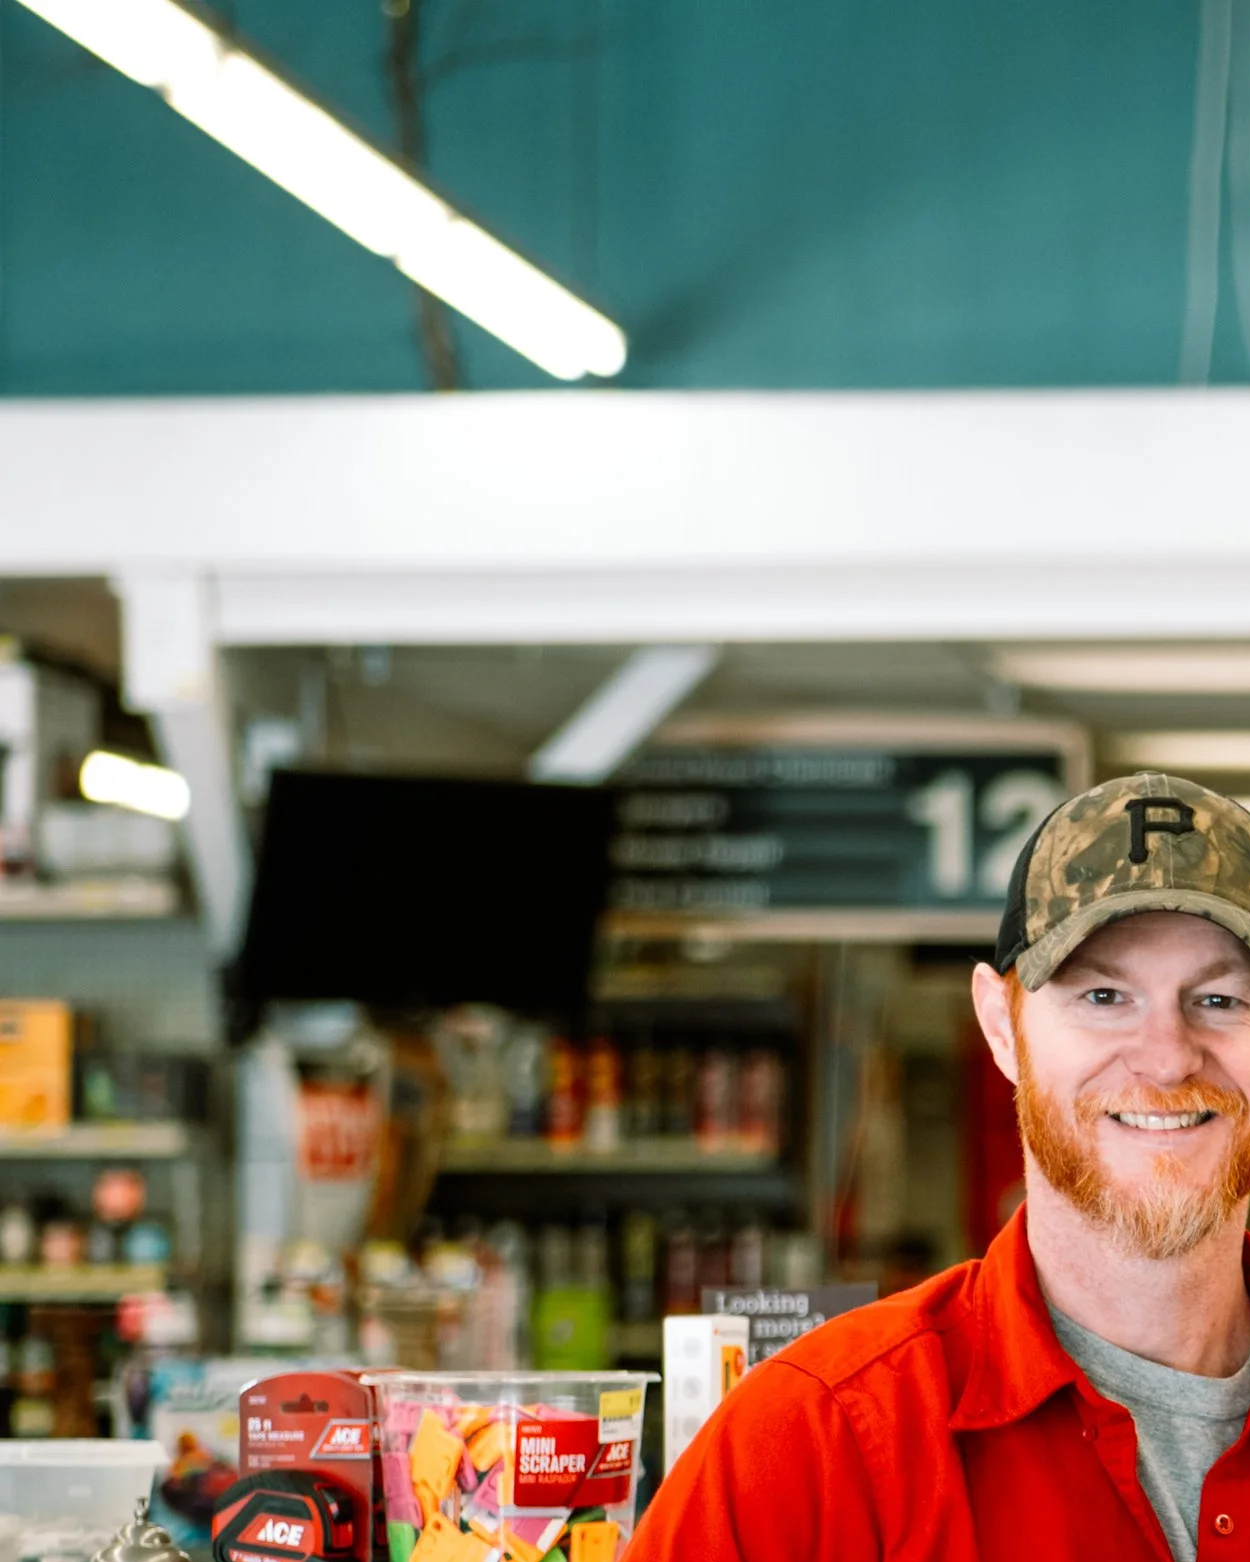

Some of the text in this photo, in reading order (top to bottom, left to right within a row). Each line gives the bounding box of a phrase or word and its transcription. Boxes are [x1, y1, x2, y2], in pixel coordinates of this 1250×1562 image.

[911, 769, 1066, 896] 12
[1125, 797, 1195, 864] P
[716, 1290, 809, 1317] Looking
[754, 1312, 825, 1338] more?
[331, 1427, 362, 1444] ACE
[520, 1437, 556, 1456] MINI
[520, 1454, 586, 1474] SCRAPER
[606, 1442, 630, 1462] ACE
[257, 1518, 304, 1547] ACE
